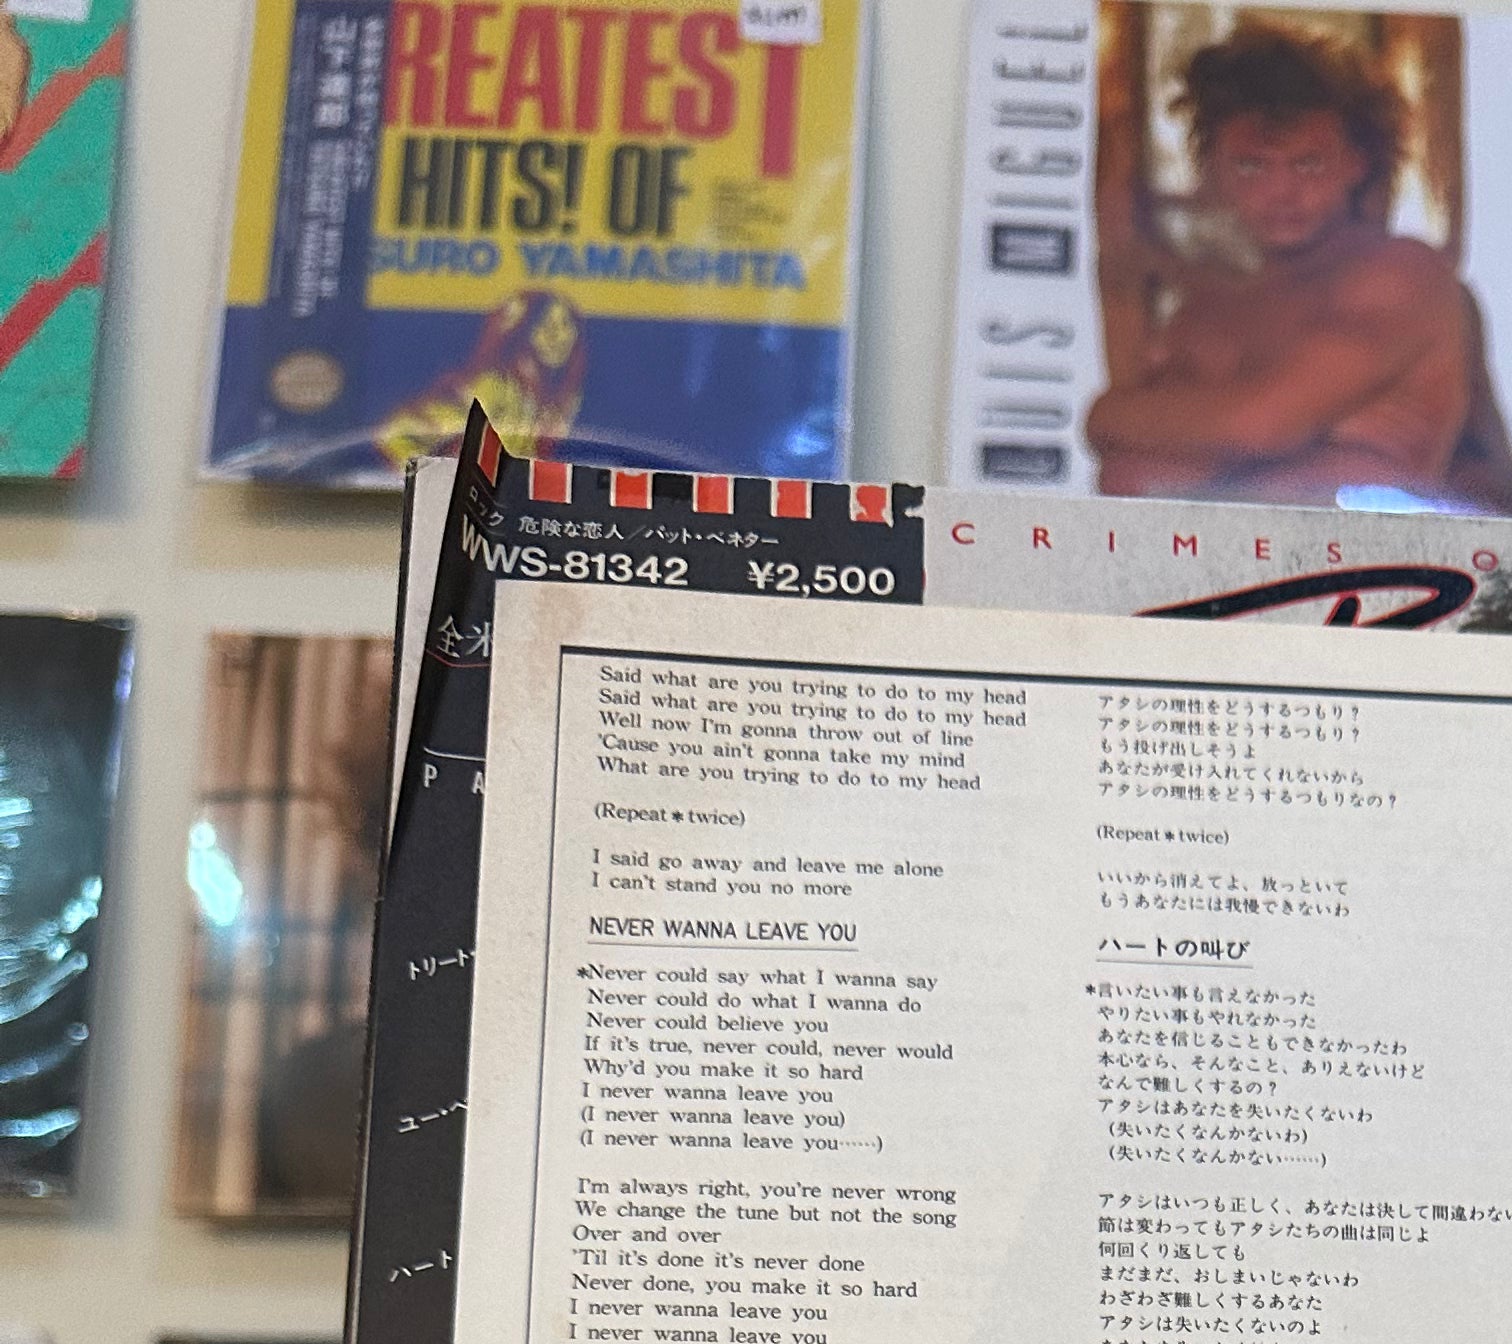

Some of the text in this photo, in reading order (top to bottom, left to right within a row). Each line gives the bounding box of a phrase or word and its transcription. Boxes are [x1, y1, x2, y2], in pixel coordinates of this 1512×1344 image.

[397, 136, 588, 236] HITS!
[607, 142, 698, 240] OF
[518, 242, 808, 292] YAMASHITA
[461, 514, 896, 598] WWS-81342 ¥2,500
[592, 871, 853, 896] I can't stand you no more
[589, 916, 857, 942] NEVER WANNA LEAVE YOU
[1098, 937, 1251, 961] ハートの叫び
[572, 1224, 722, 1244] Over and over
[1098, 1240, 1245, 1262] 何回くり返しても
